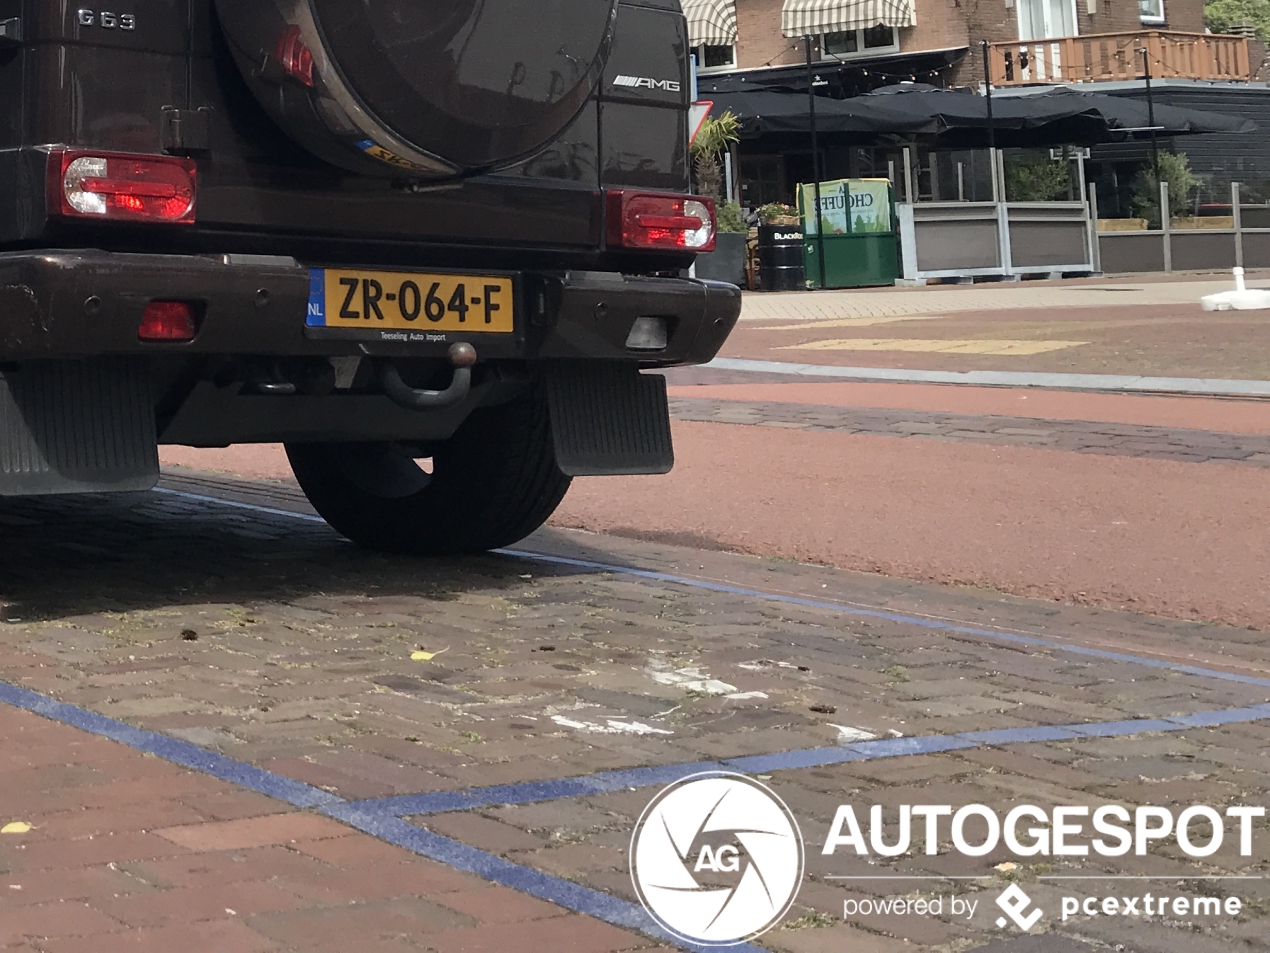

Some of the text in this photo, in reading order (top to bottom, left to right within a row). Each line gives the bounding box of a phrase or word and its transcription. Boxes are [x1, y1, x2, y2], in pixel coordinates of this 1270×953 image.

[634, 76, 680, 92] AMG
[307, 277, 502, 324] NL ZR-064-F
[380, 331, 446, 341] Teeseling Auto Import
